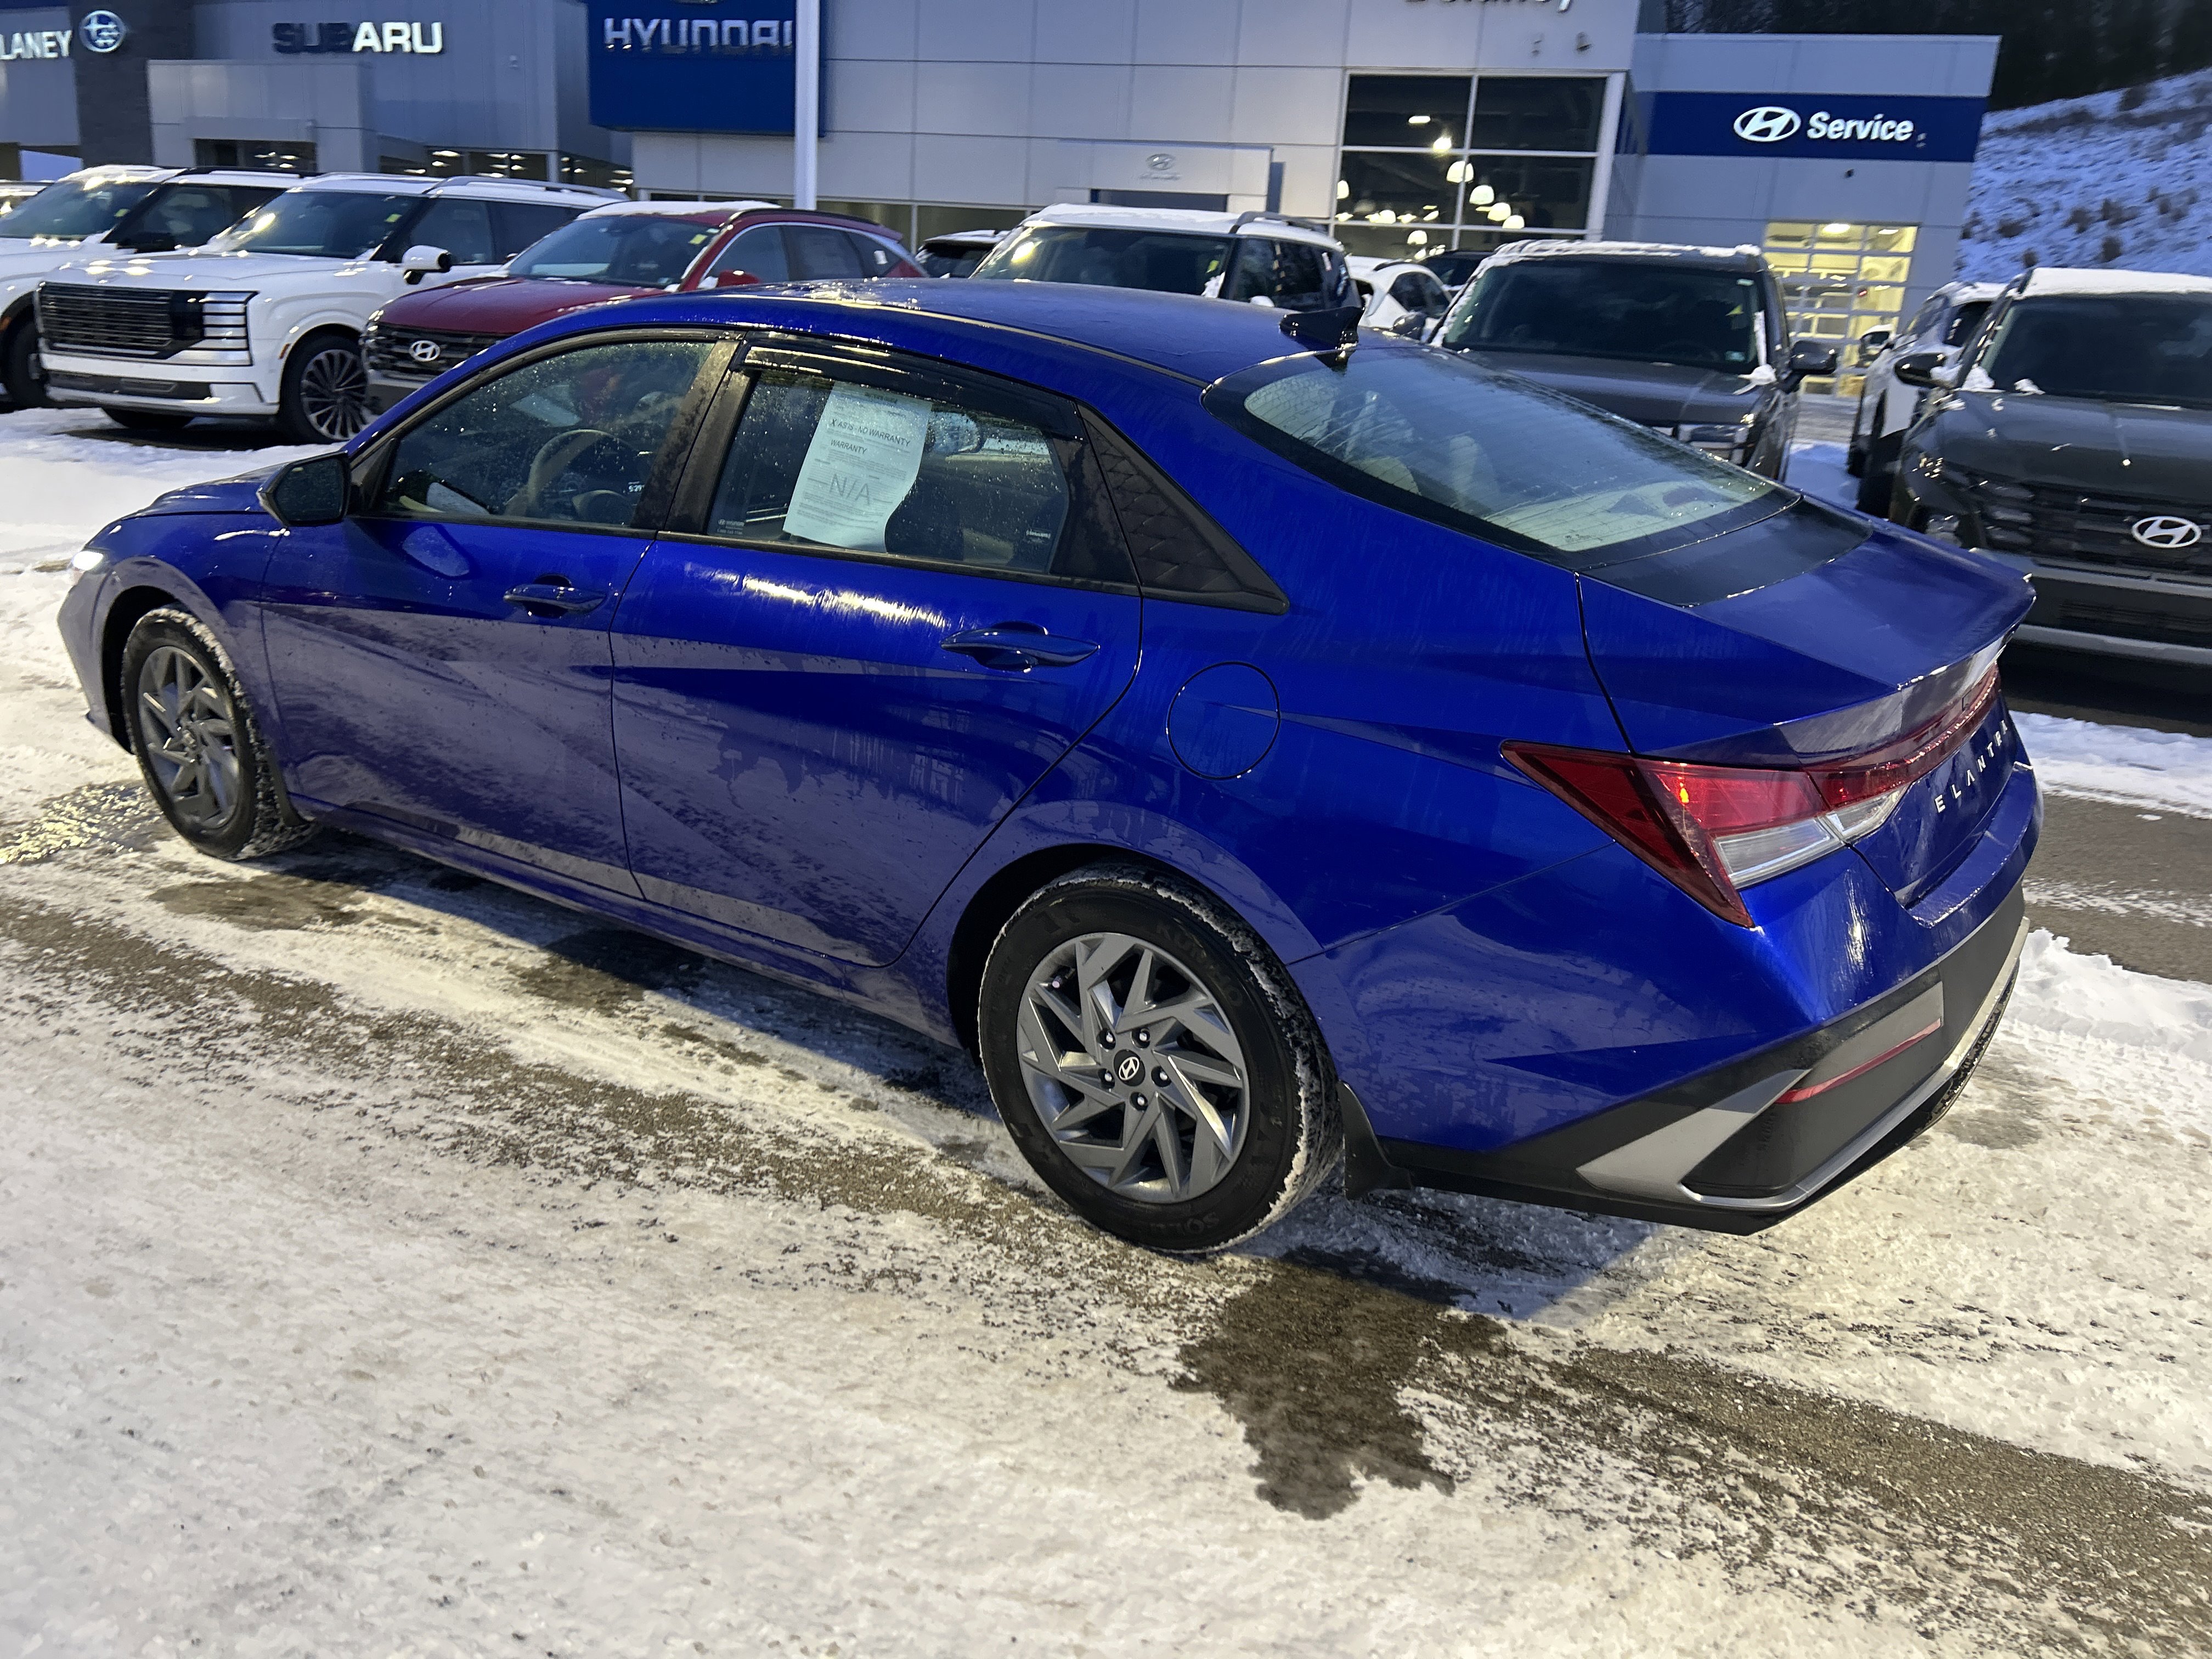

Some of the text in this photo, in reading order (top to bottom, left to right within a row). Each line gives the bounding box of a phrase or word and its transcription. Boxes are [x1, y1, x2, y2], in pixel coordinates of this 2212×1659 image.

[272, 21, 443, 53] SUBARU
[603, 18, 793, 47] HYUNDAI
[1807, 111, 1914, 141] Service
[831, 439, 867, 455] WARRANTY
[838, 421, 847, 429] AS
[859, 426, 868, 434] NO
[869, 428, 911, 447] WARRANTY
[829, 473, 870, 506] N/A
[1934, 720, 2008, 813] ELANTRA
